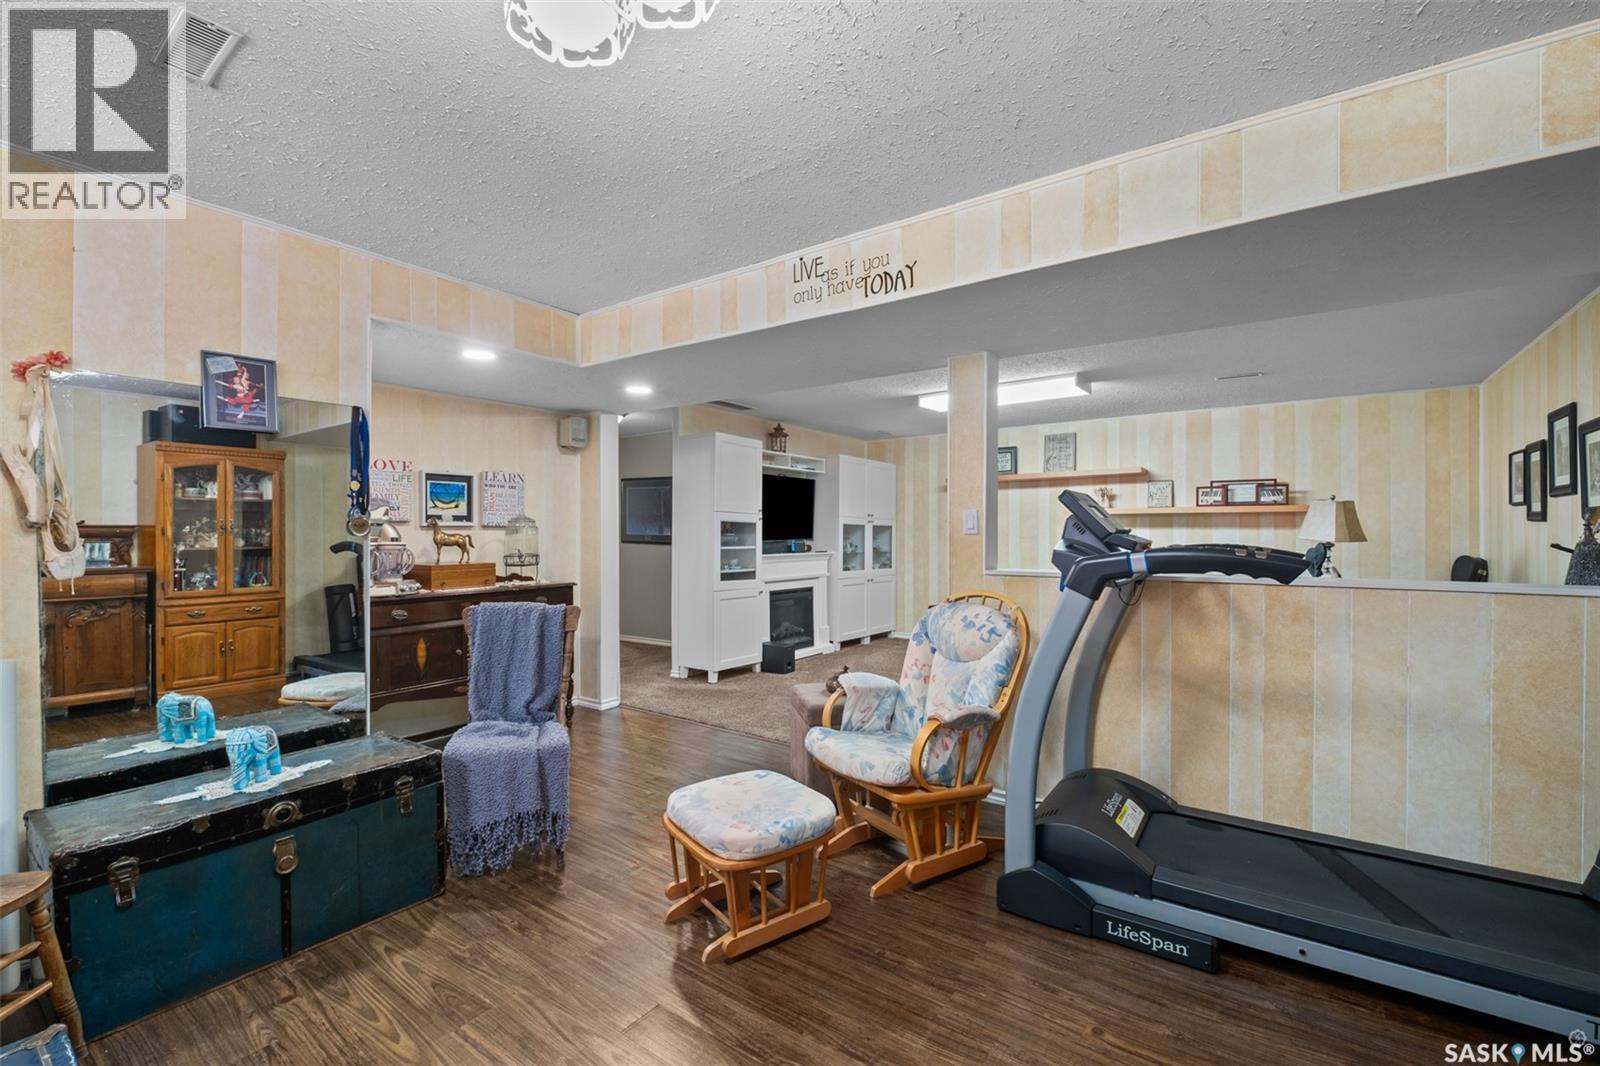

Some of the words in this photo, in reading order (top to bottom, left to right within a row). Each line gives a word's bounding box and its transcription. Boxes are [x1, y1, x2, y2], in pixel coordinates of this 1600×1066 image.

[821, 268, 838, 283] as
[845, 259, 856, 276] if
[863, 253, 890, 275] you
[793, 286, 822, 304] only
[827, 276, 864, 296] have
[863, 260, 917, 298] TODAY
[370, 459, 412, 472] OVE
[392, 474, 412, 483] LIFE
[484, 471, 524, 483] LEARN
[1106, 920, 1189, 957] LifeSpan
